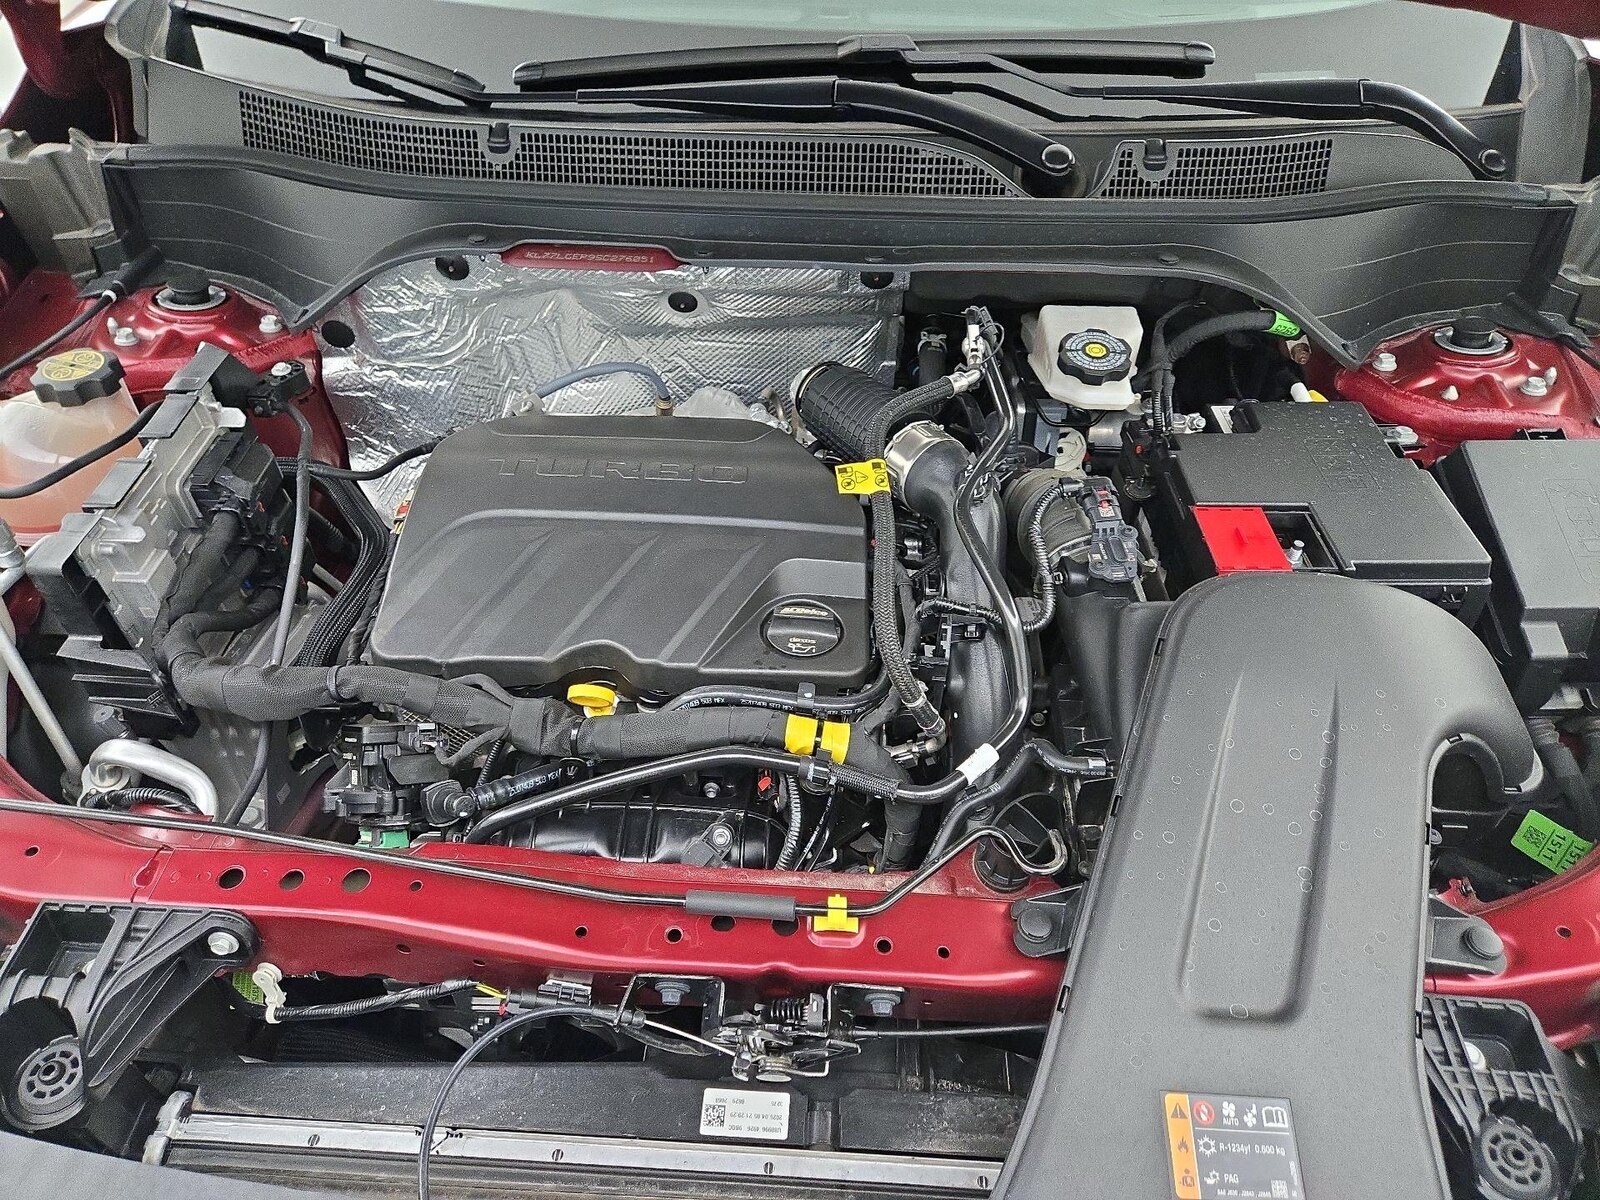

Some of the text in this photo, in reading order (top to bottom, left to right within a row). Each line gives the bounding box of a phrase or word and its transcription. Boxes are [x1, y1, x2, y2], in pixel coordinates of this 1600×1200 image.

[487, 458, 748, 484] TURBO
[1542, 833, 1567, 862] 1511
[1222, 1117, 1239, 1126] AUTO
[1275, 1145, 1286, 1156] kg
[1223, 1173, 1239, 1184] PAG
